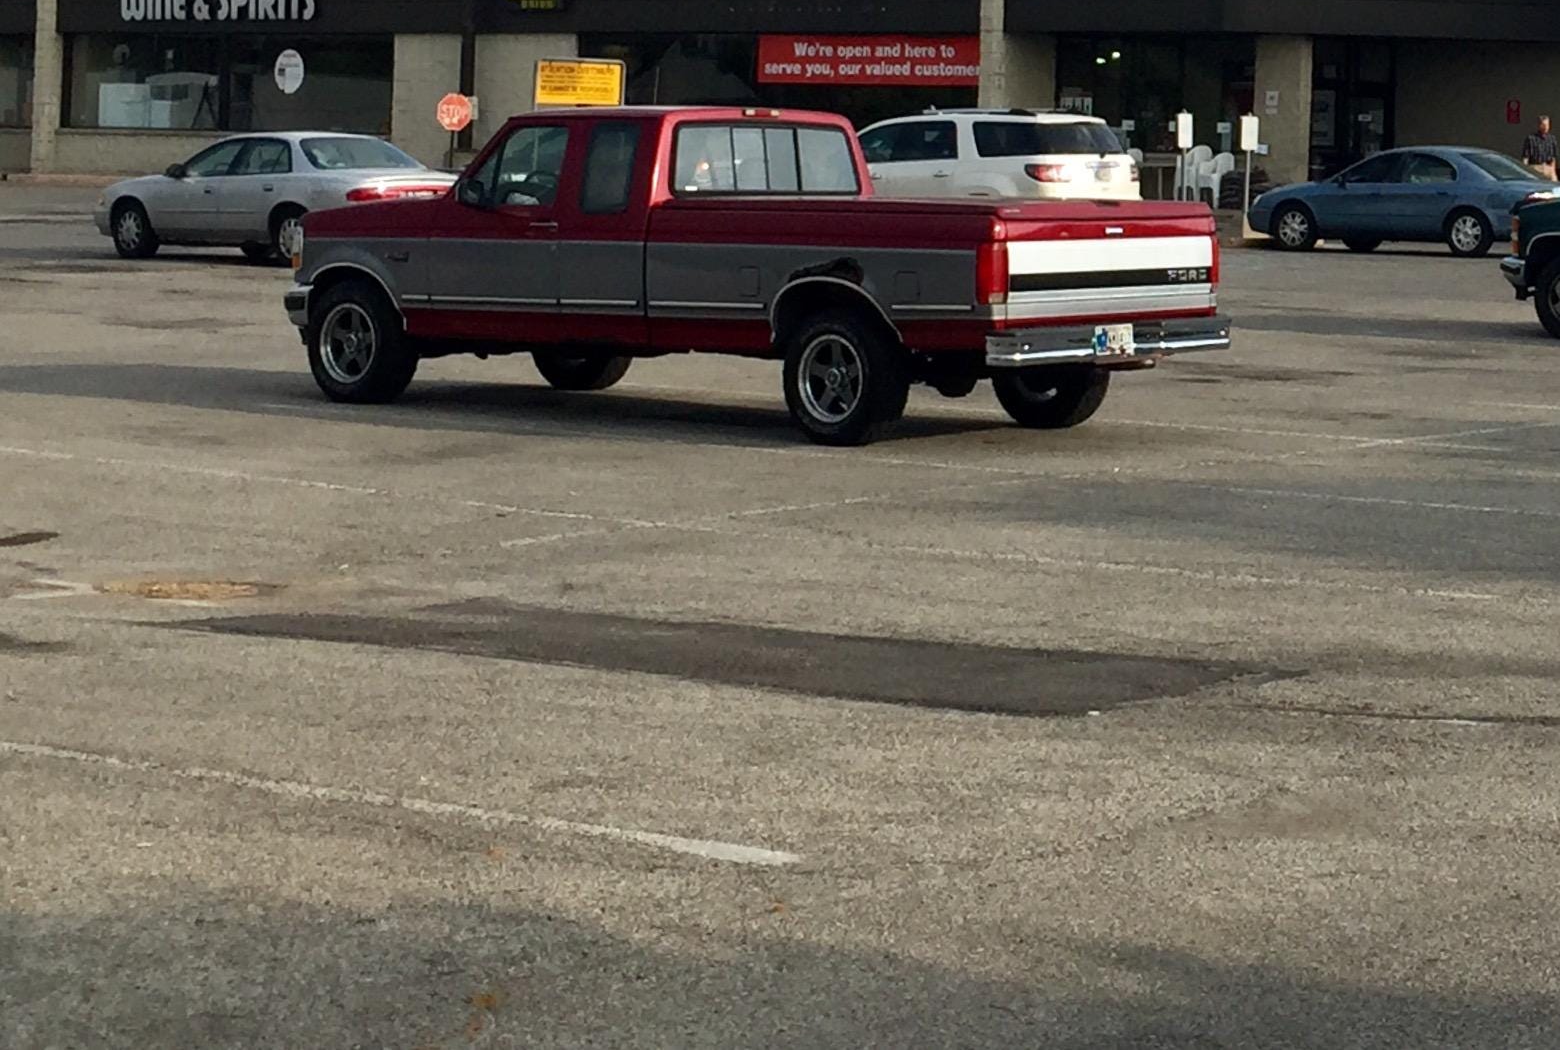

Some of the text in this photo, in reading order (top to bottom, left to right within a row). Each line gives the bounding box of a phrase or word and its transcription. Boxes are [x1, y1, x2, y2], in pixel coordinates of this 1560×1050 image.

[793, 42, 955, 59] We're open and here to
[764, 63, 801, 75] serve
[806, 63, 834, 77] you,
[838, 63, 861, 76] our
[865, 61, 911, 76] valued
[439, 104, 469, 118] STOP
[1167, 269, 1207, 281] FORD
